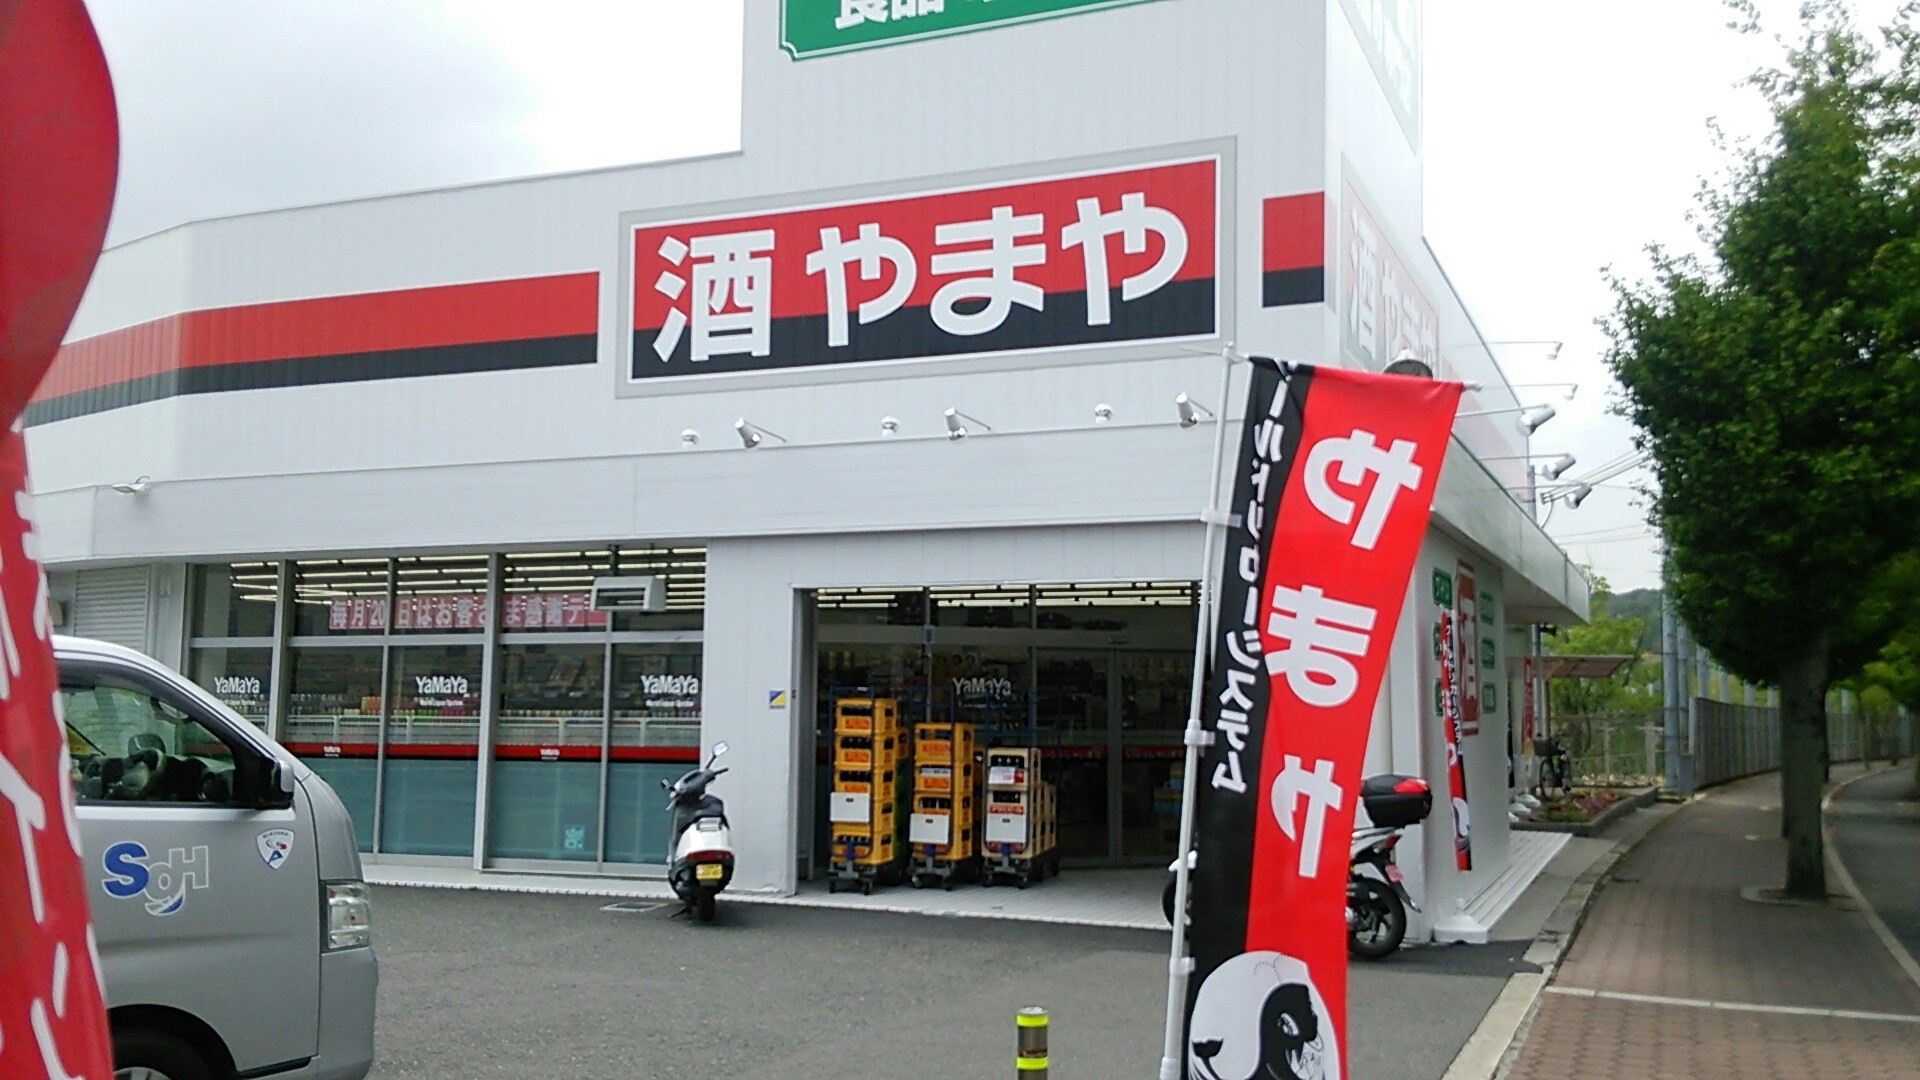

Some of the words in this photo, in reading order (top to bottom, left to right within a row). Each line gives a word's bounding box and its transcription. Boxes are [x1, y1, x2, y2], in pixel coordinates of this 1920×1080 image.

[652, 228, 776, 363] 酒
[805, 192, 1189, 348] やまや
[213, 676, 260, 693] YaMaYa
[415, 676, 468, 694] YaMaYa
[640, 675, 699, 694] YaMaYa
